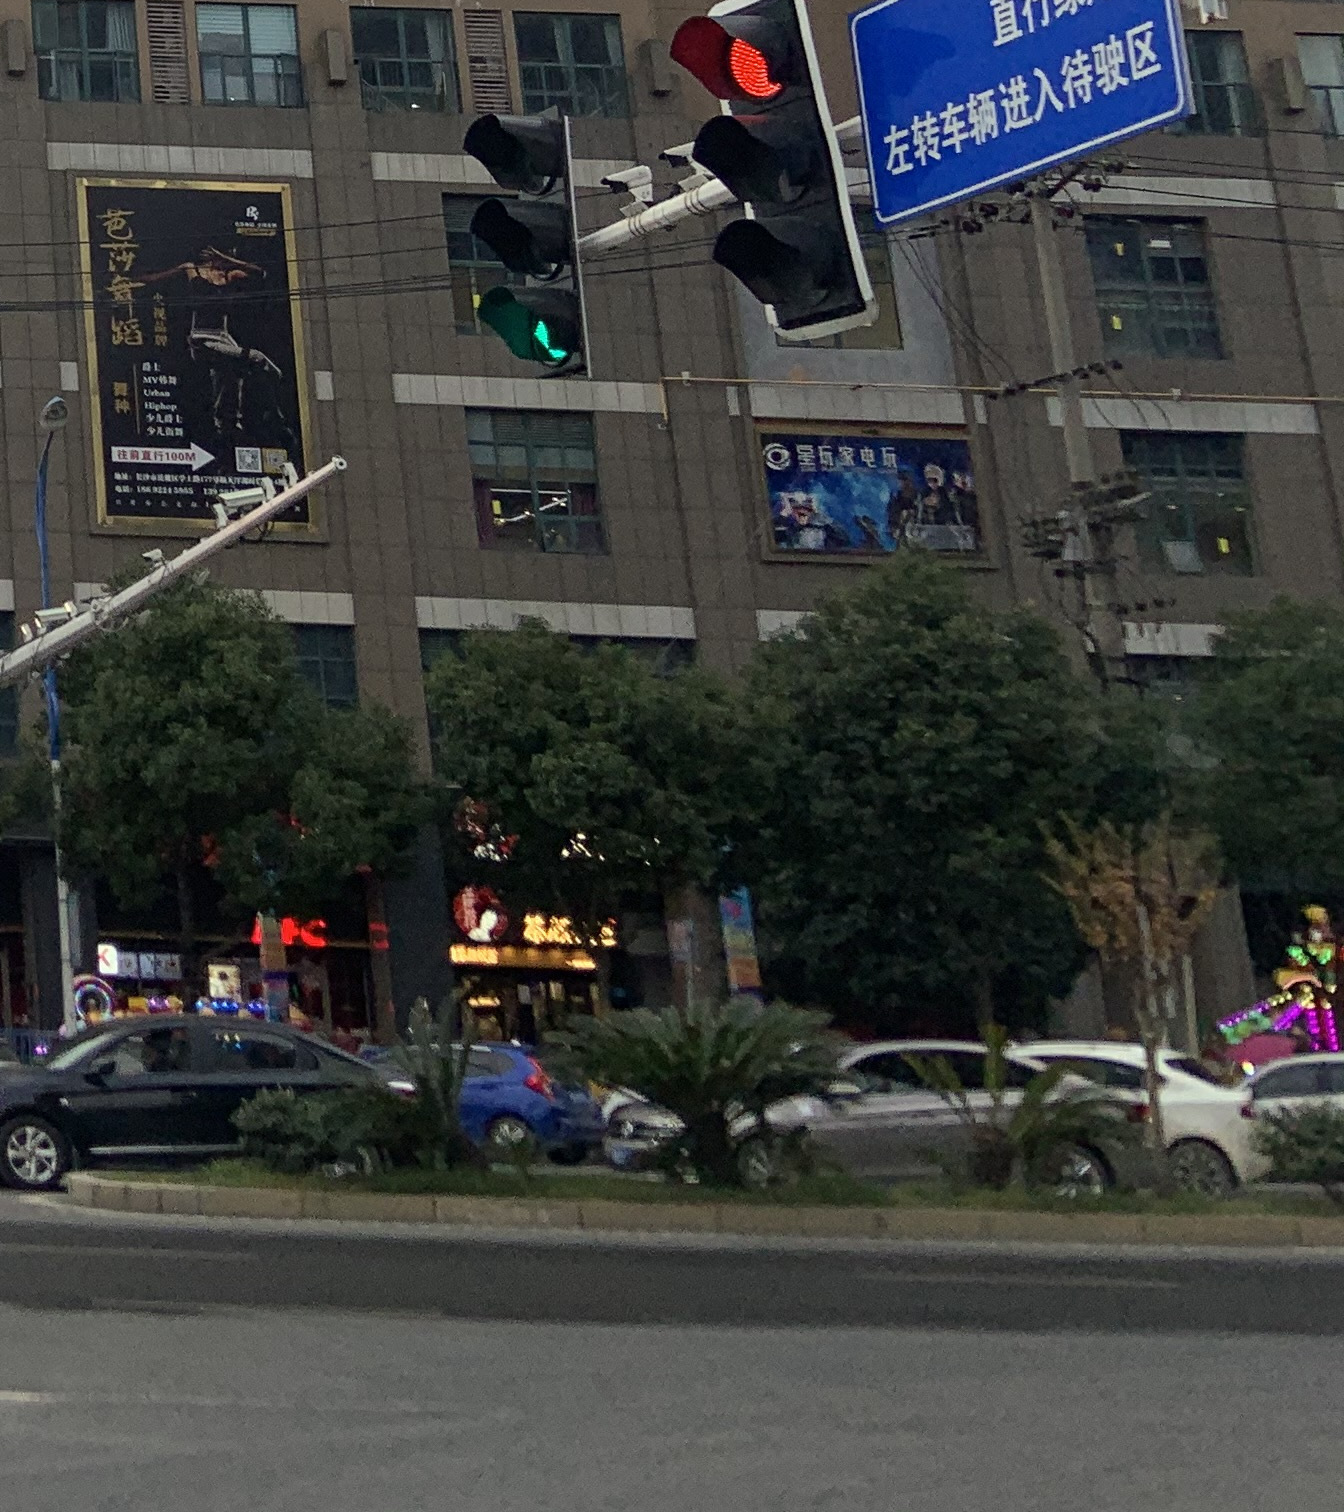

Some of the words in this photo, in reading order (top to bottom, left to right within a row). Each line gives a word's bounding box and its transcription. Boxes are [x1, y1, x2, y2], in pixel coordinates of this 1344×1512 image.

[883, 20, 1163, 176] 左转车辆进入待驶区
[143, 389, 171, 397] Urban
[144, 401, 178, 412] Hiphop
